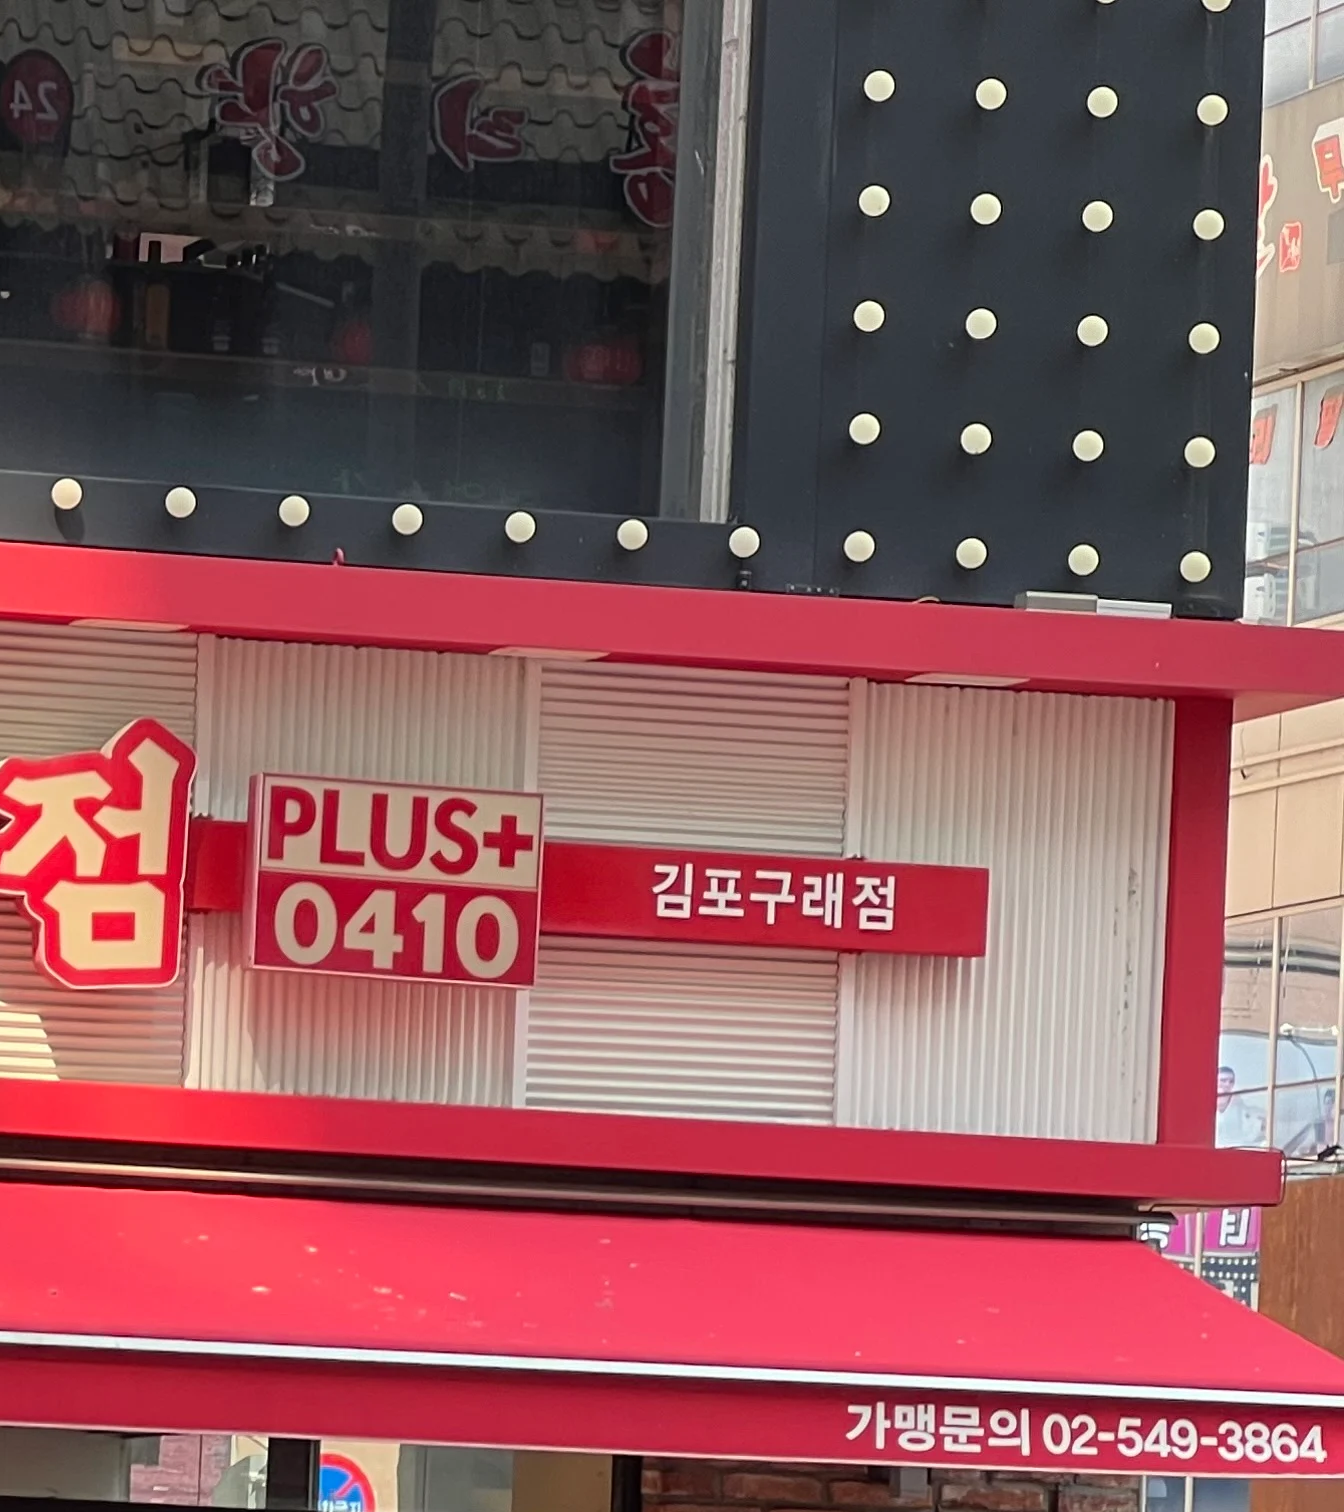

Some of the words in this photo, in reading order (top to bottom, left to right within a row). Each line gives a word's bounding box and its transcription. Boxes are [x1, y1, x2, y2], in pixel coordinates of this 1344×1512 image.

[266, 785, 533, 876] PLUS+
[273, 882, 519, 979] 0410
[652, 863, 898, 932] 김포구래점
[845, 1400, 1031, 1457] 가맹문의
[1041, 1412, 1327, 1464] 02-549-3864
